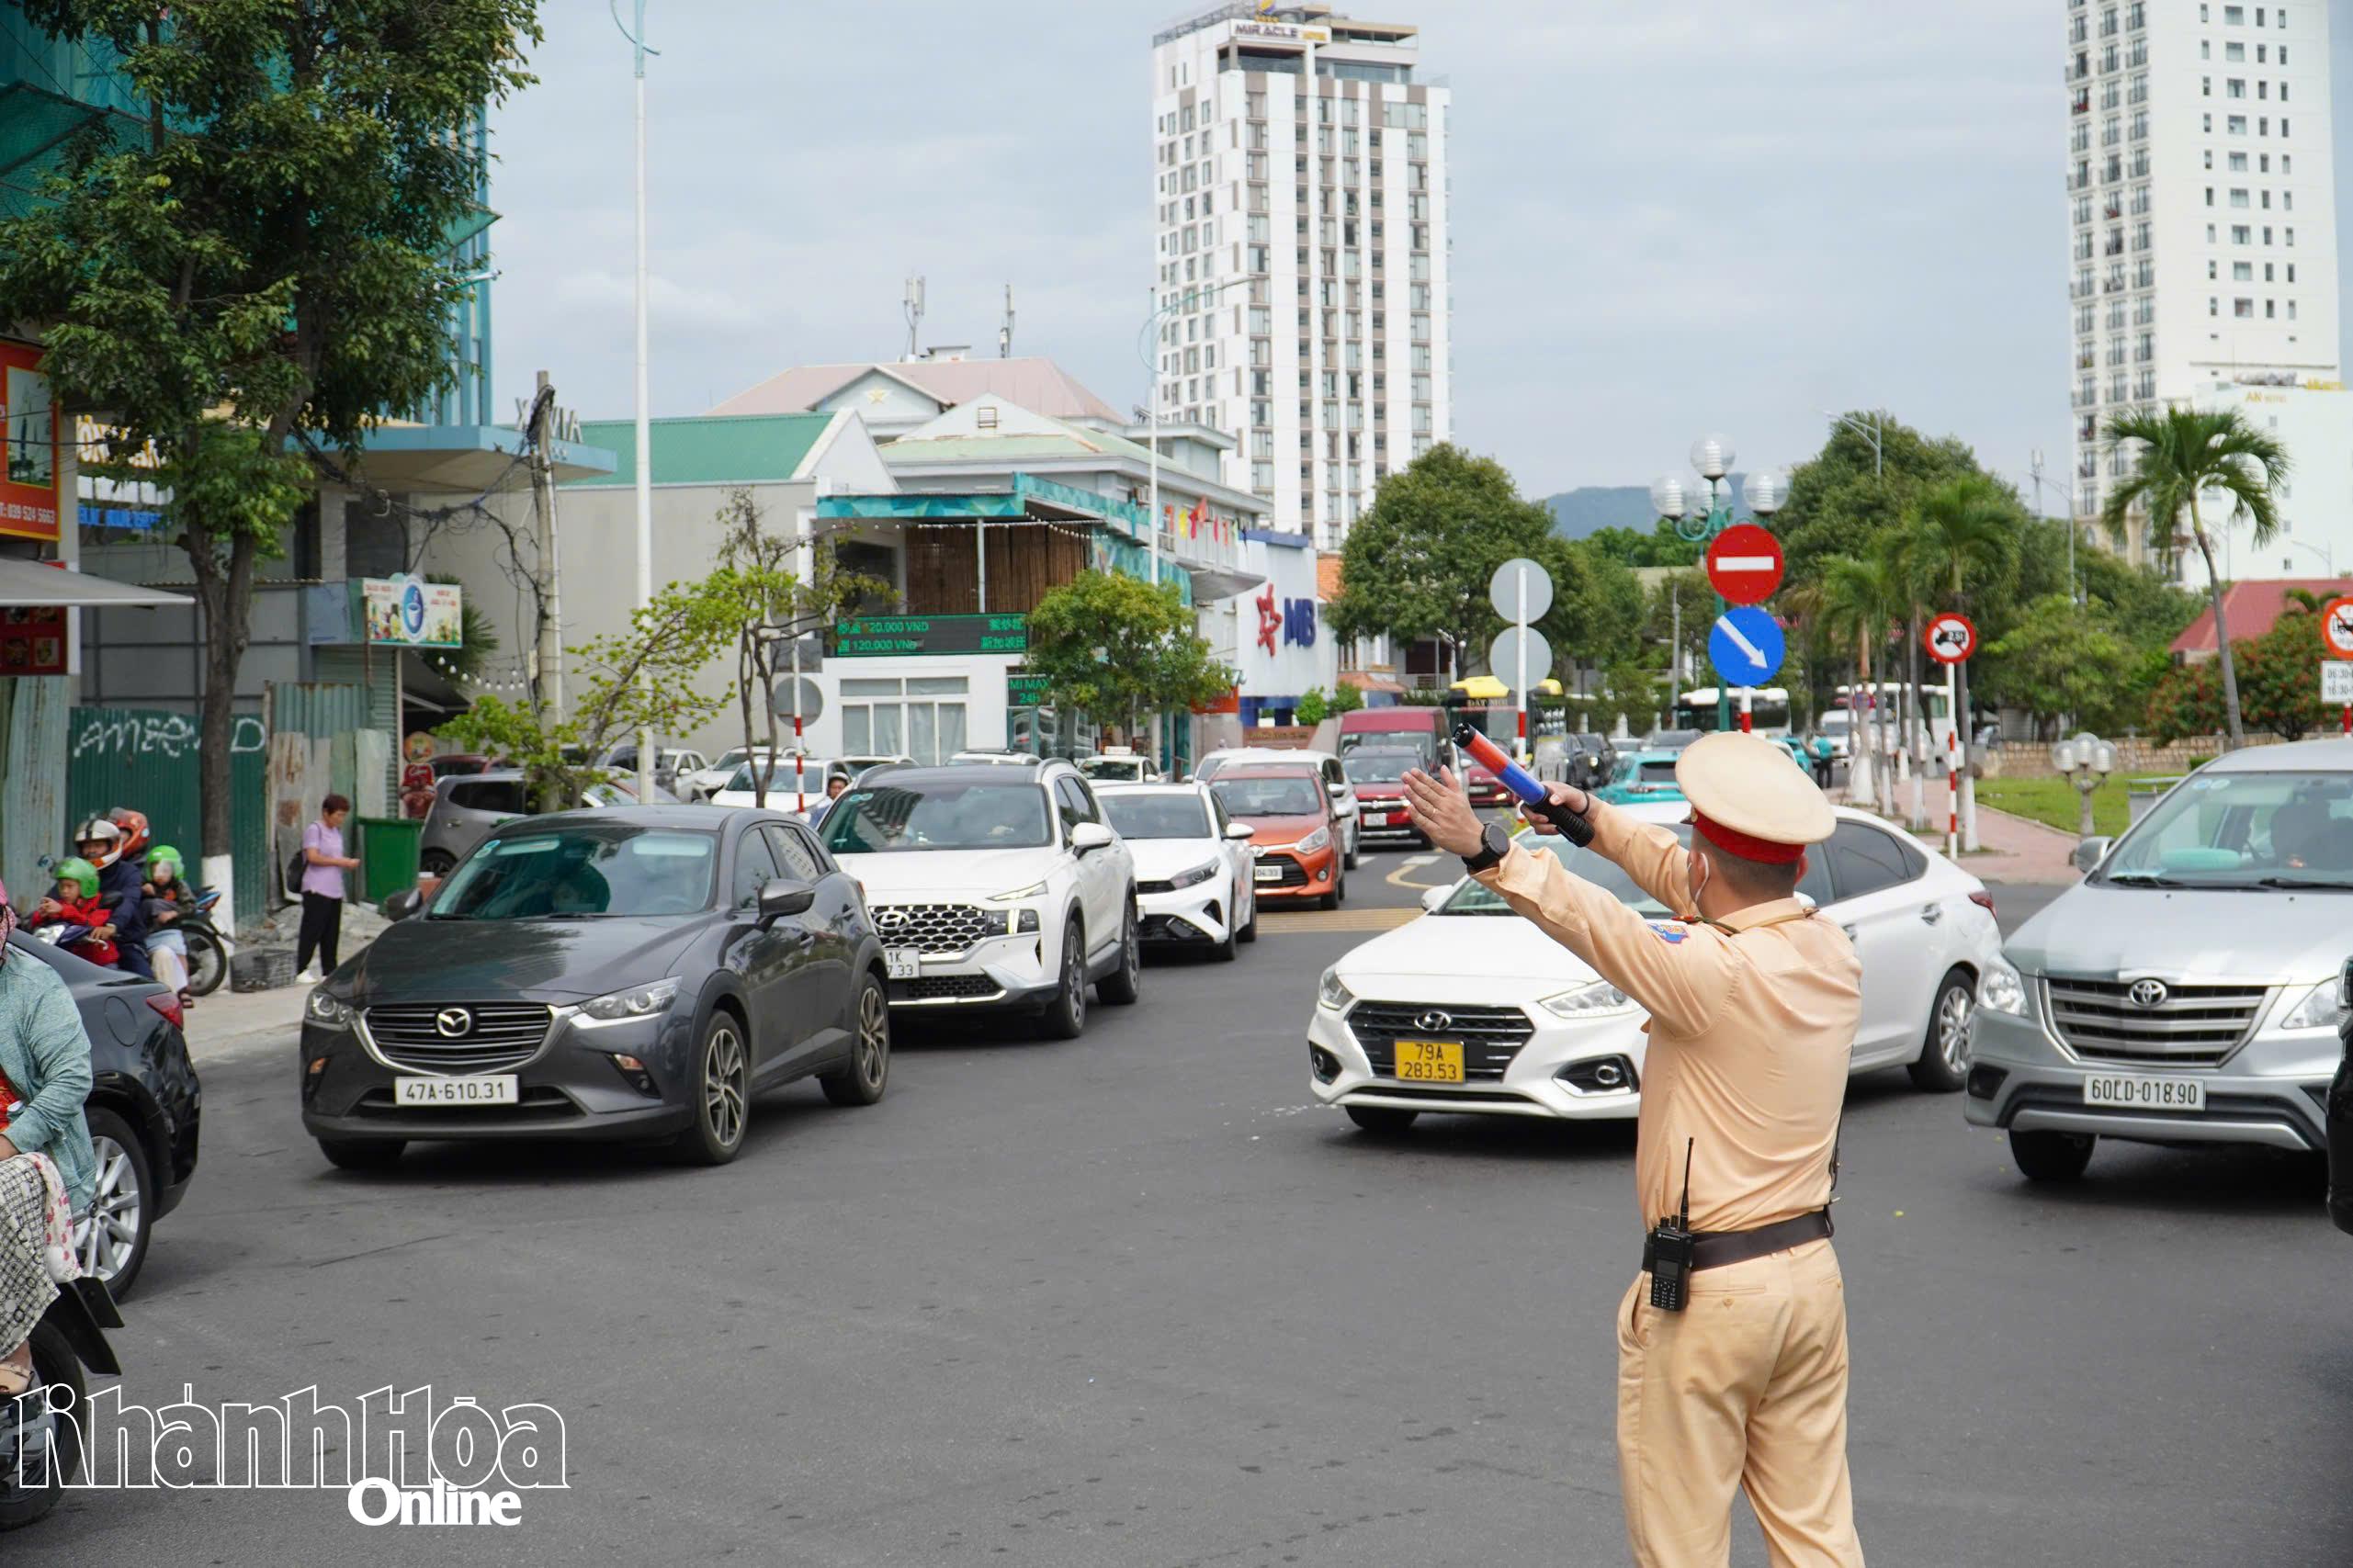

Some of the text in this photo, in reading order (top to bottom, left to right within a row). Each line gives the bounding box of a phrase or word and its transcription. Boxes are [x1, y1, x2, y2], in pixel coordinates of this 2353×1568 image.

[1235, 24, 1298, 37] MIRACLE
[1284, 597, 1316, 648] MB
[1416, 1043, 1443, 1060] 79A
[1403, 1062, 1457, 1080] 283.53
[405, 1082, 504, 1100] 47A-610.31
